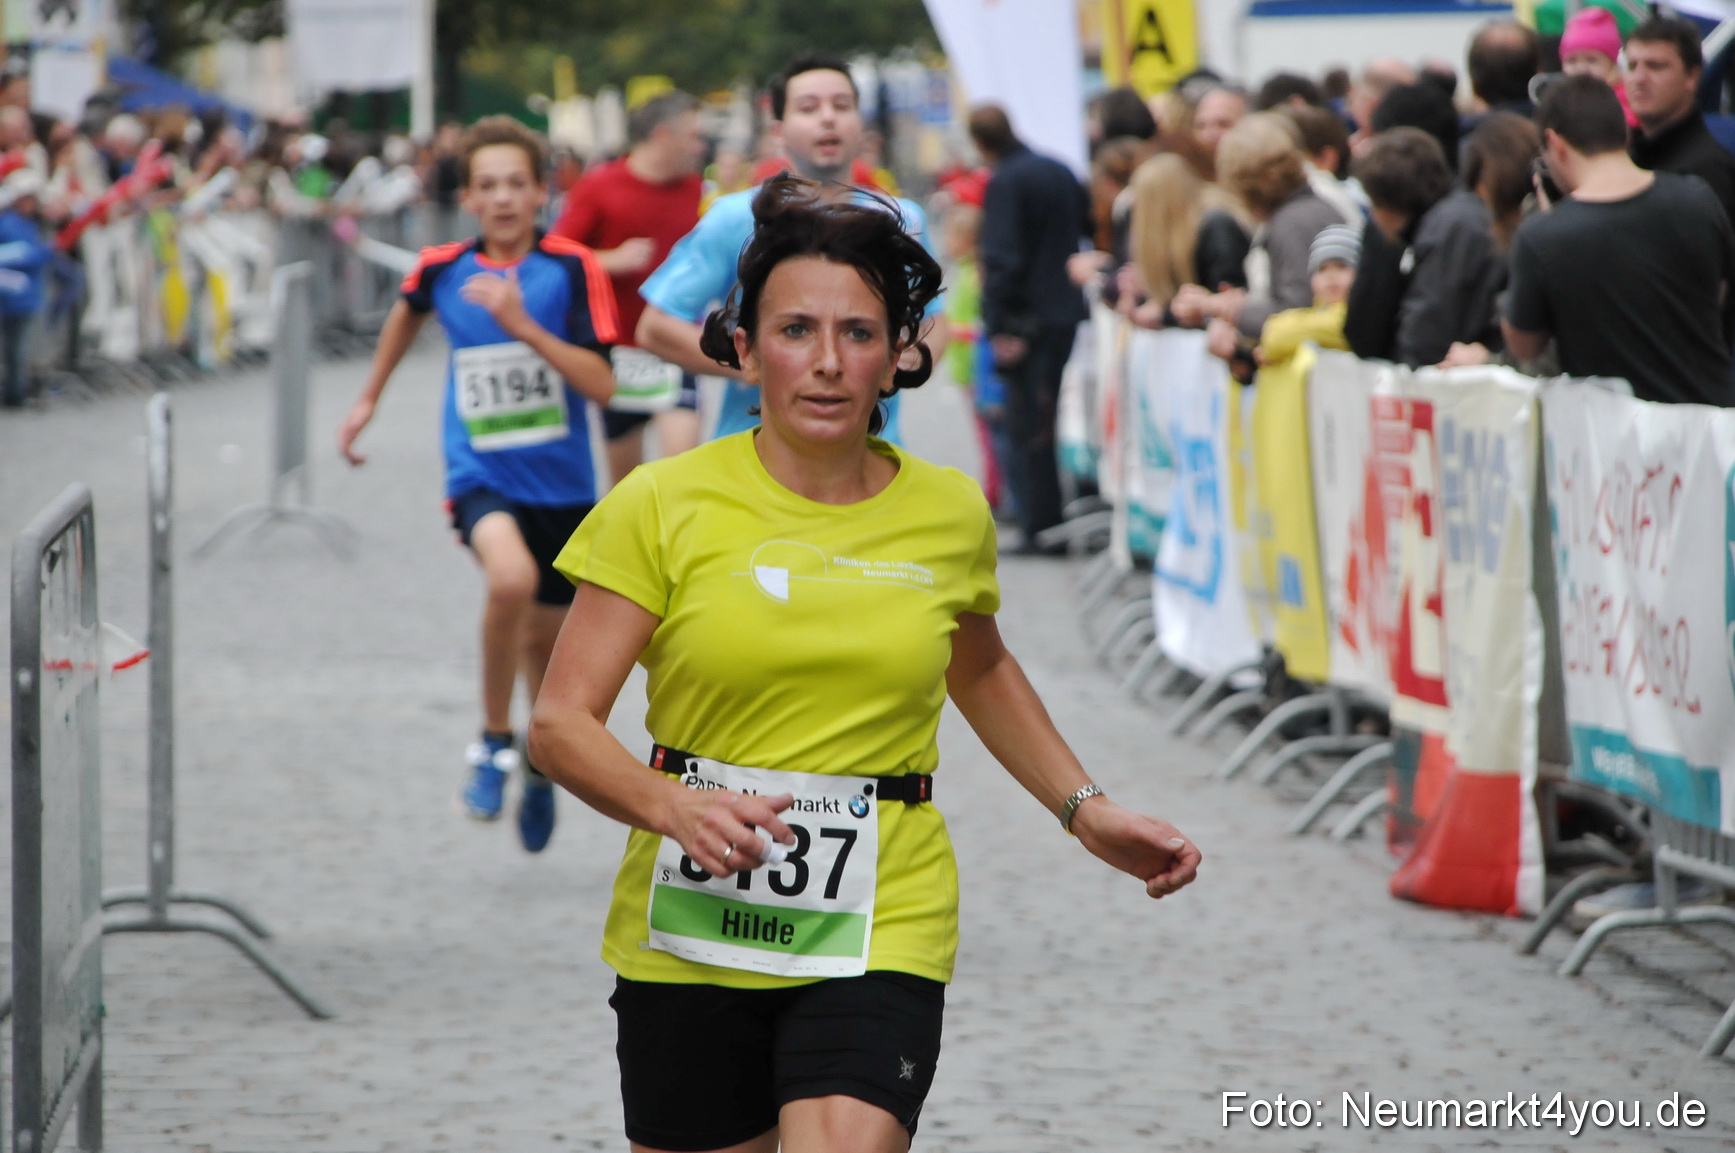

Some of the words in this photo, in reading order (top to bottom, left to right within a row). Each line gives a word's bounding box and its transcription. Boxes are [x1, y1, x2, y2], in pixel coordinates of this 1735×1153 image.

[1130, 8, 1174, 65] A
[465, 367, 551, 407] 5194
[833, 556, 871, 568] Kliniken
[863, 569, 908, 579] Neumarkt
[684, 775, 728, 792] PAR
[742, 788, 841, 814] markt
[661, 870, 671, 882] S
[721, 908, 795, 945] Hilde
